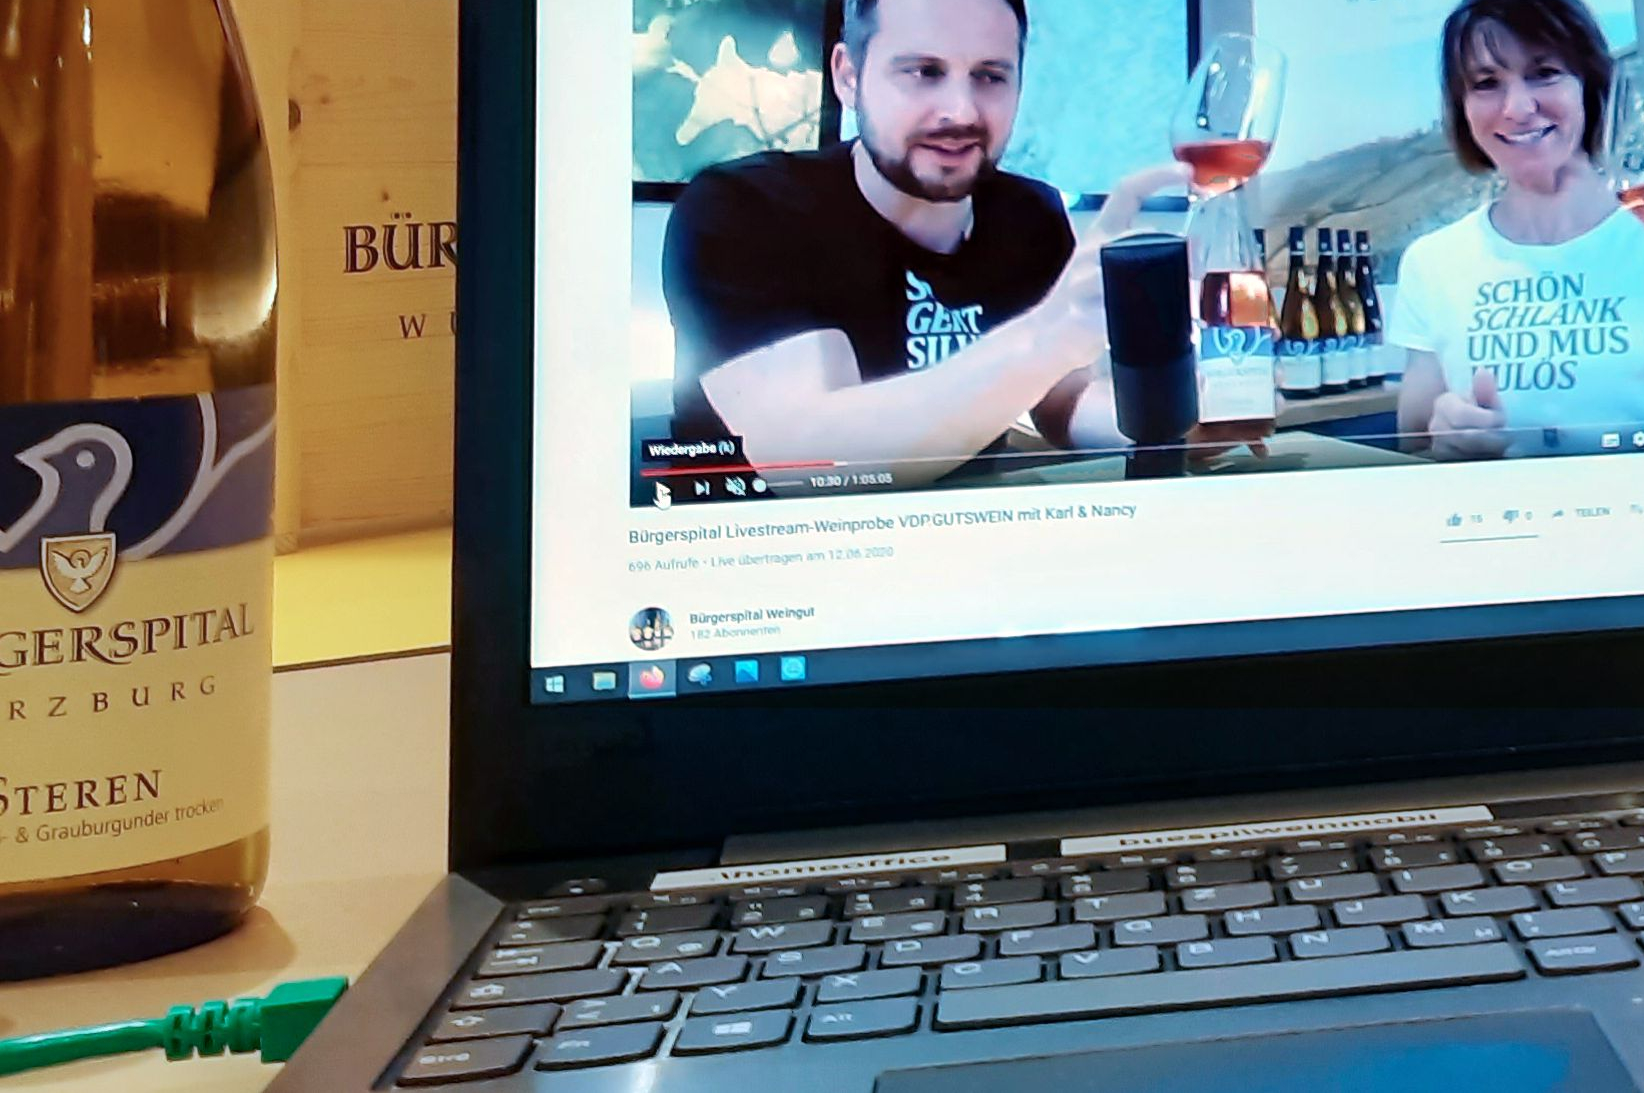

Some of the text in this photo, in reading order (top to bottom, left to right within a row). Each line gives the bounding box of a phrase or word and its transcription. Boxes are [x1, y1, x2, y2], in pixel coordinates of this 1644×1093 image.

[1475, 272, 1585, 307] SCHÖN
[1467, 296, 1627, 333] SCHLANK
[1467, 325, 1630, 362] UND MUS
[1472, 357, 1578, 392] ULÖS
[649, 442, 717, 457] Wiedergabe
[629, 524, 722, 545] Bürgerspital
[726, 516, 895, 540] Livestream-Weinprobe
[1018, 507, 1041, 521] mit
[1045, 505, 1074, 520] Karl
[1078, 506, 1087, 518] &
[1091, 504, 1137, 519] Nancy
[655, 557, 699, 572] Aufrufe
[711, 555, 735, 567] Live
[738, 552, 802, 567] übertragen
[807, 551, 825, 561] am
[690, 607, 815, 626] Bürgerspital Weingut
[714, 626, 781, 639] Abonnenten
[15, 796, 225, 845] & Grauburgunder trocken
[750, 925, 785, 939] W
